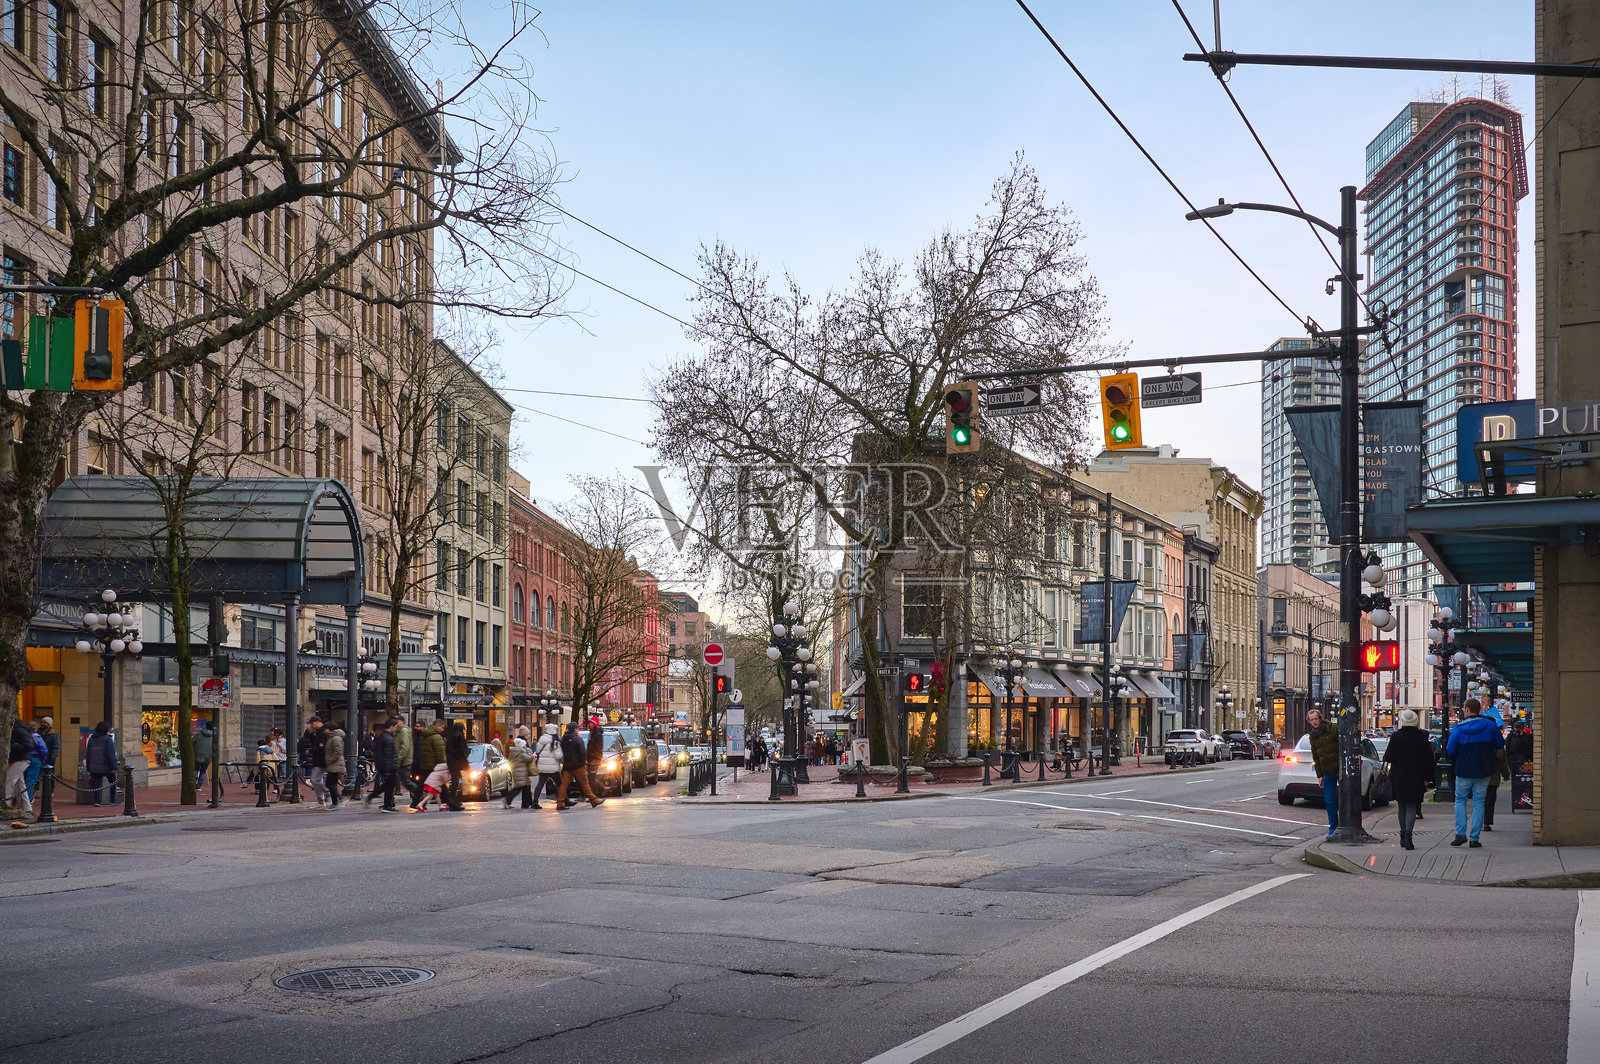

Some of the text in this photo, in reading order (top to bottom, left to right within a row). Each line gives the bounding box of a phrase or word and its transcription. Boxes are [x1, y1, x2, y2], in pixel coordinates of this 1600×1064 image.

[1145, 381, 1184, 394] ONE WAY
[990, 392, 1025, 404] ONE WAY
[1145, 399, 1165, 407] EXCEPT
[1183, 395, 1197, 403] LANE
[991, 407, 1009, 416] EXCEPT
[1024, 404, 1038, 412] LANE
[1365, 444, 1421, 454] GASTOWN
[1365, 458, 1388, 466] GLAD
[1365, 481, 1388, 490] MADE
[1366, 494, 1376, 502] IT
